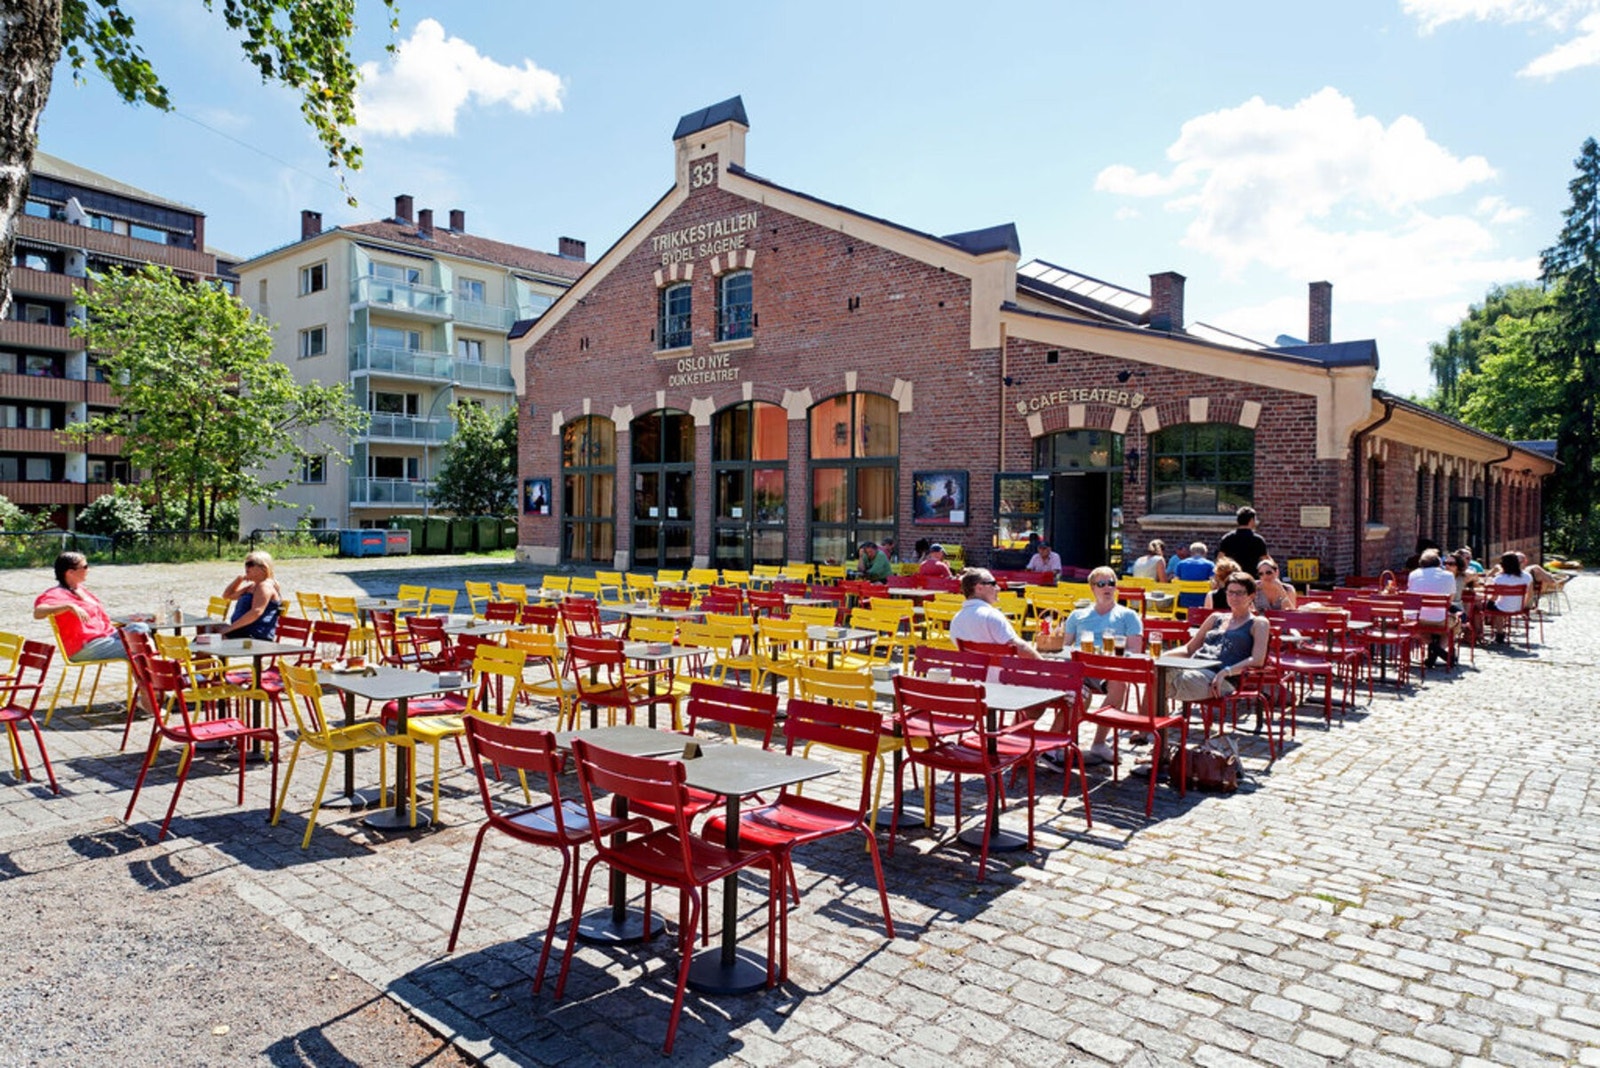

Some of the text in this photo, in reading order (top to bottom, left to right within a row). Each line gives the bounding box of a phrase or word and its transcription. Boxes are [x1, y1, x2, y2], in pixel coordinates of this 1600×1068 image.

[693, 162, 714, 188] 33
[652, 212, 758, 252] TRIKKESTALLEN
[662, 234, 745, 266] BYDEL SAGENE
[677, 353, 730, 373] OSLO NYE
[669, 367, 740, 387] DUKKETEATRET
